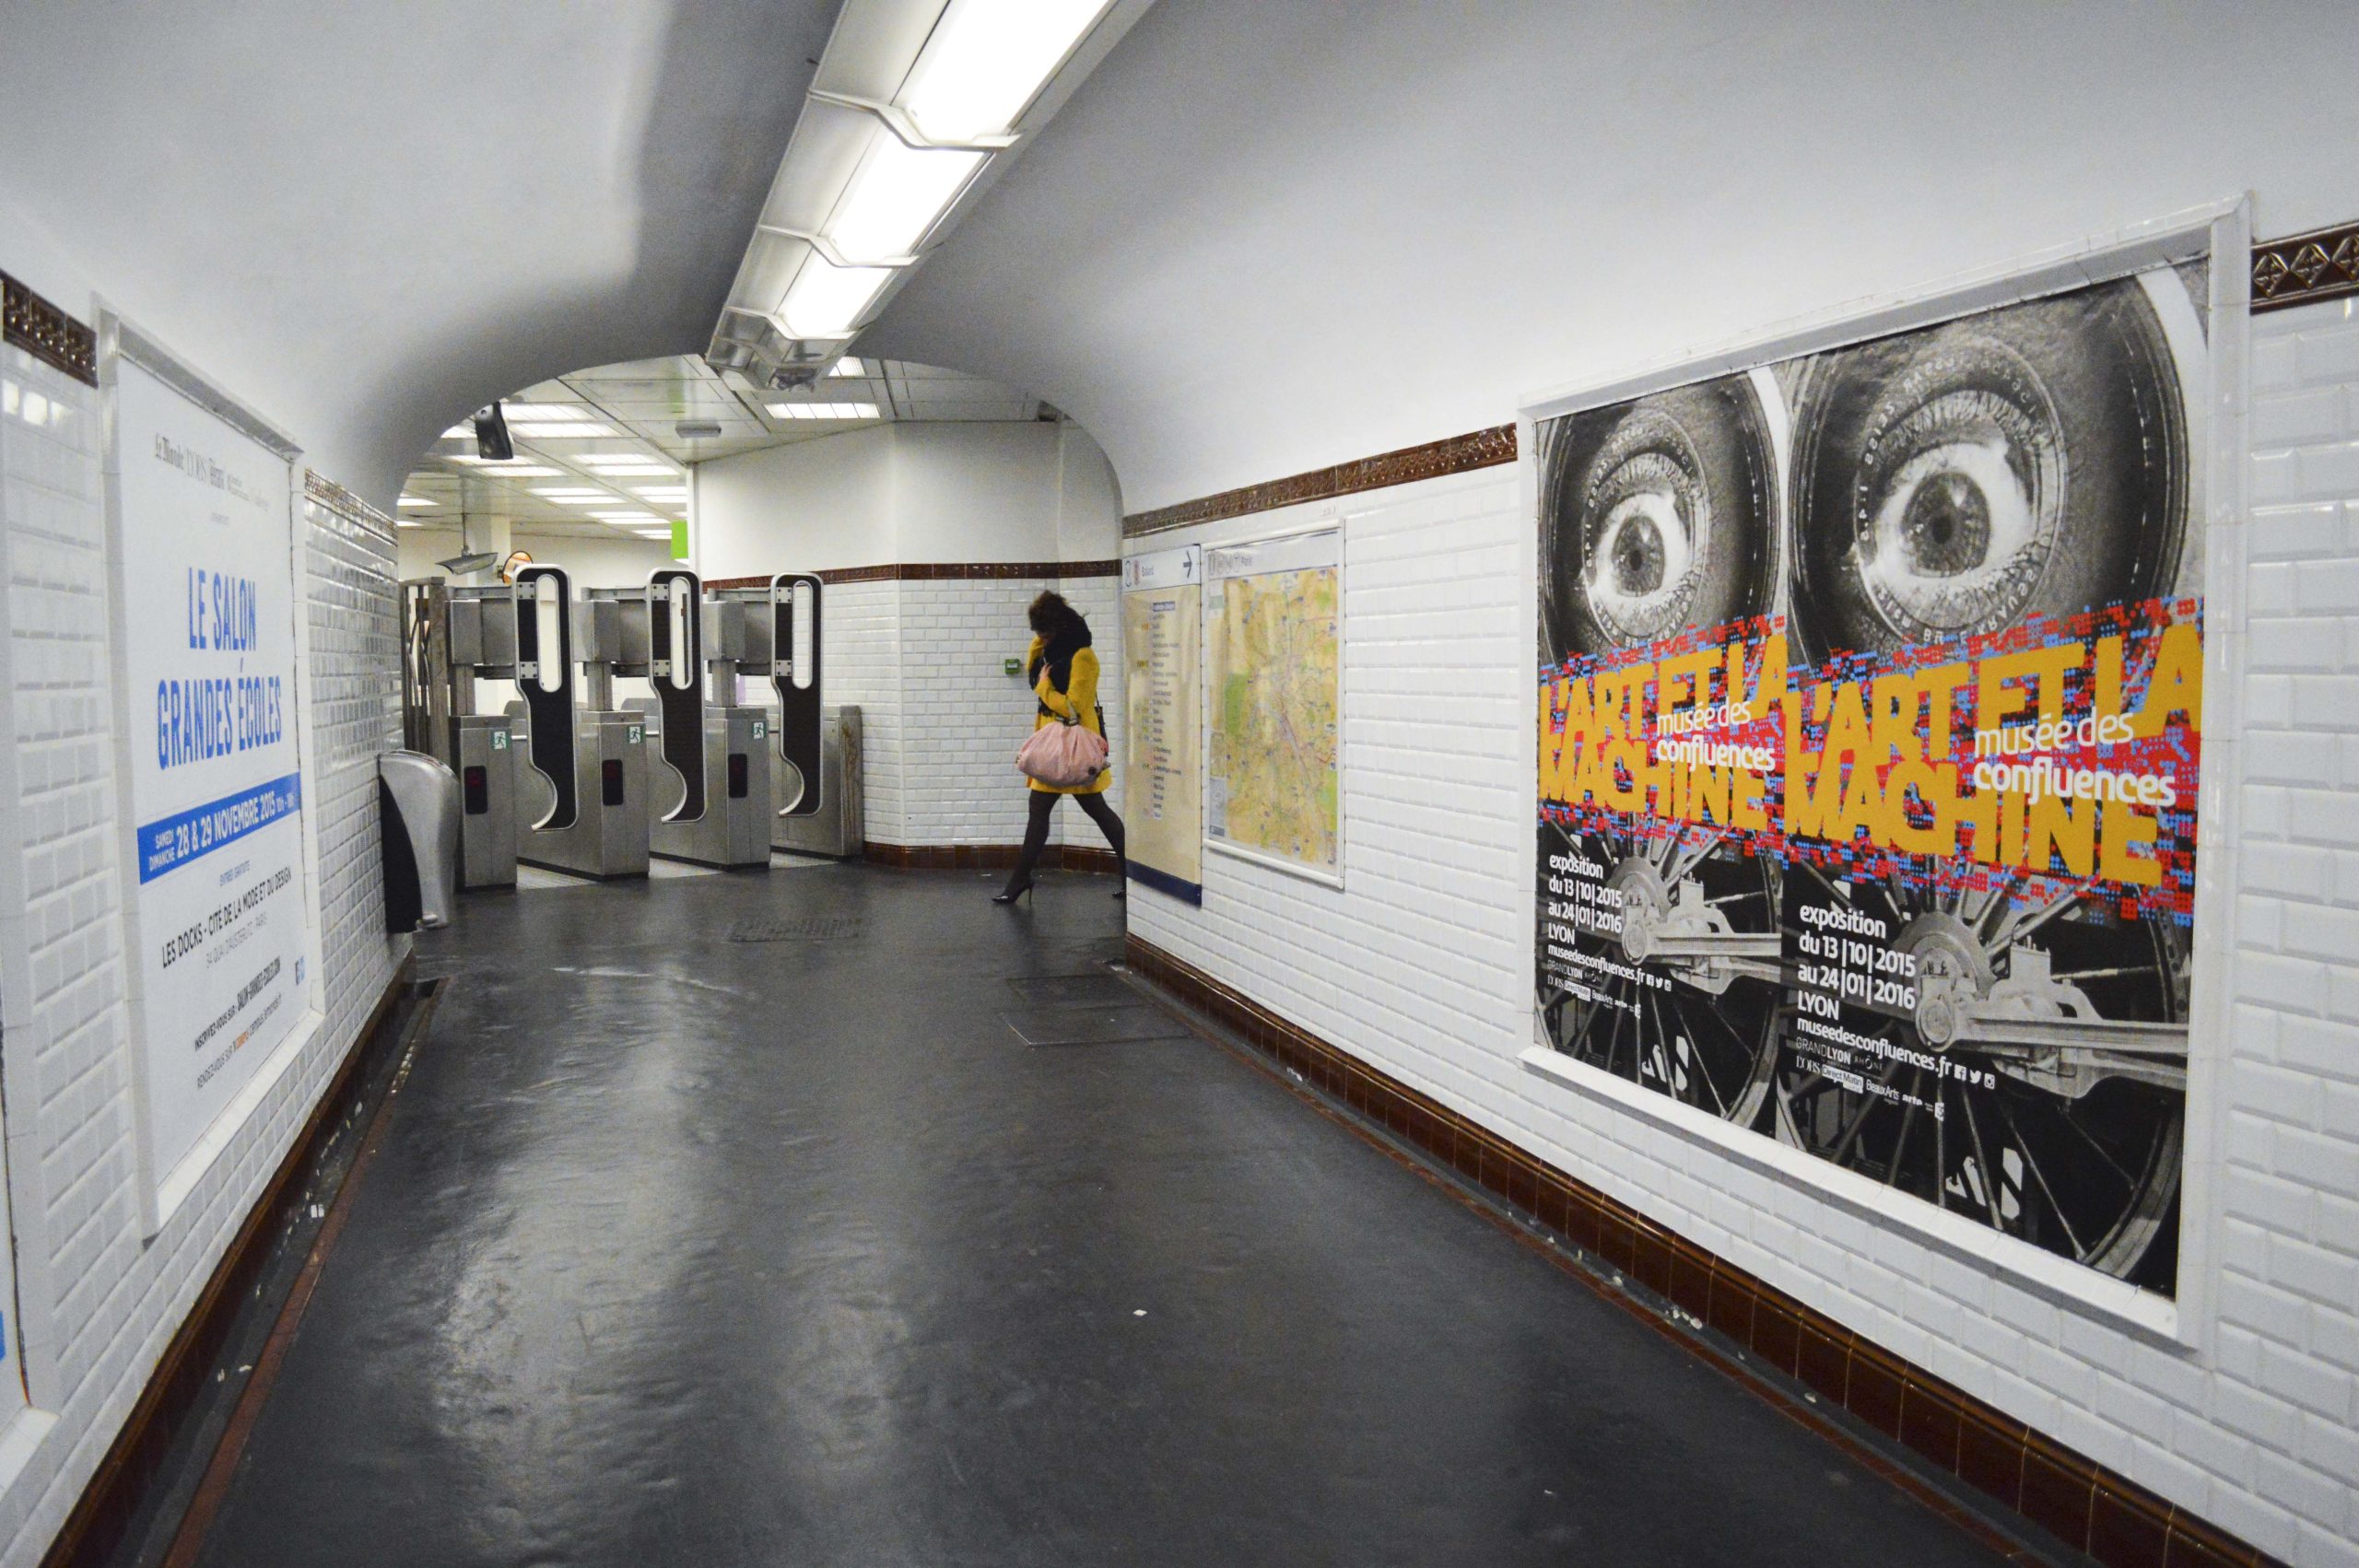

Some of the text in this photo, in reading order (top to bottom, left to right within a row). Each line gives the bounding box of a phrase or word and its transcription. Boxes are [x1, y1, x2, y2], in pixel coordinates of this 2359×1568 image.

[189, 567, 256, 652] LE SALON
[158, 656, 282, 770] GRANDES ÉCOLES
[1537, 661, 1656, 743] L'ART
[1658, 647, 1724, 728] ET
[1785, 661, 1970, 761] L'ART
[1978, 642, 2086, 742] ET
[1656, 696, 1752, 737] musée des
[1974, 707, 2135, 759] musée des
[1656, 733, 1776, 773] confluences
[1537, 740, 1768, 828] MACHINE
[1973, 755, 2177, 807] confluences
[155, 828, 174, 849] SAMEDI
[176, 823, 191, 860] 28
[192, 819, 199, 852] &
[201, 814, 213, 848] 29
[214, 796, 260, 842] NOVEMBRE
[260, 790, 276, 821] 2015
[1784, 757, 2164, 887] MACHINE
[148, 847, 176, 872] DIMANCHE
[1549, 854, 1603, 880] exposition
[1548, 874, 1563, 895] du
[161, 945, 178, 969] LES
[178, 921, 203, 958] DOCKS
[208, 903, 223, 937] CITÉ
[224, 902, 233, 926] DE
[233, 897, 242, 920] LA
[242, 885, 259, 913] MODE
[259, 880, 266, 902] ET
[266, 875, 275, 896] DU
[275, 865, 292, 892] DESIGN
[1548, 901, 1562, 918] au
[1799, 904, 1886, 940] exposition
[1548, 922, 1576, 945] LYON
[1799, 930, 1820, 955] du
[1547, 943, 1646, 986] museedesconfluences.fr
[1797, 964, 1818, 985] au
[1797, 989, 1839, 1021] LYON
[1796, 1017, 1953, 1079] museedesconfluences.fr
[1823, 1066, 1842, 1081] Direct
[1843, 1072, 1863, 1087] Matin
[1902, 1094, 1923, 1106] arte
